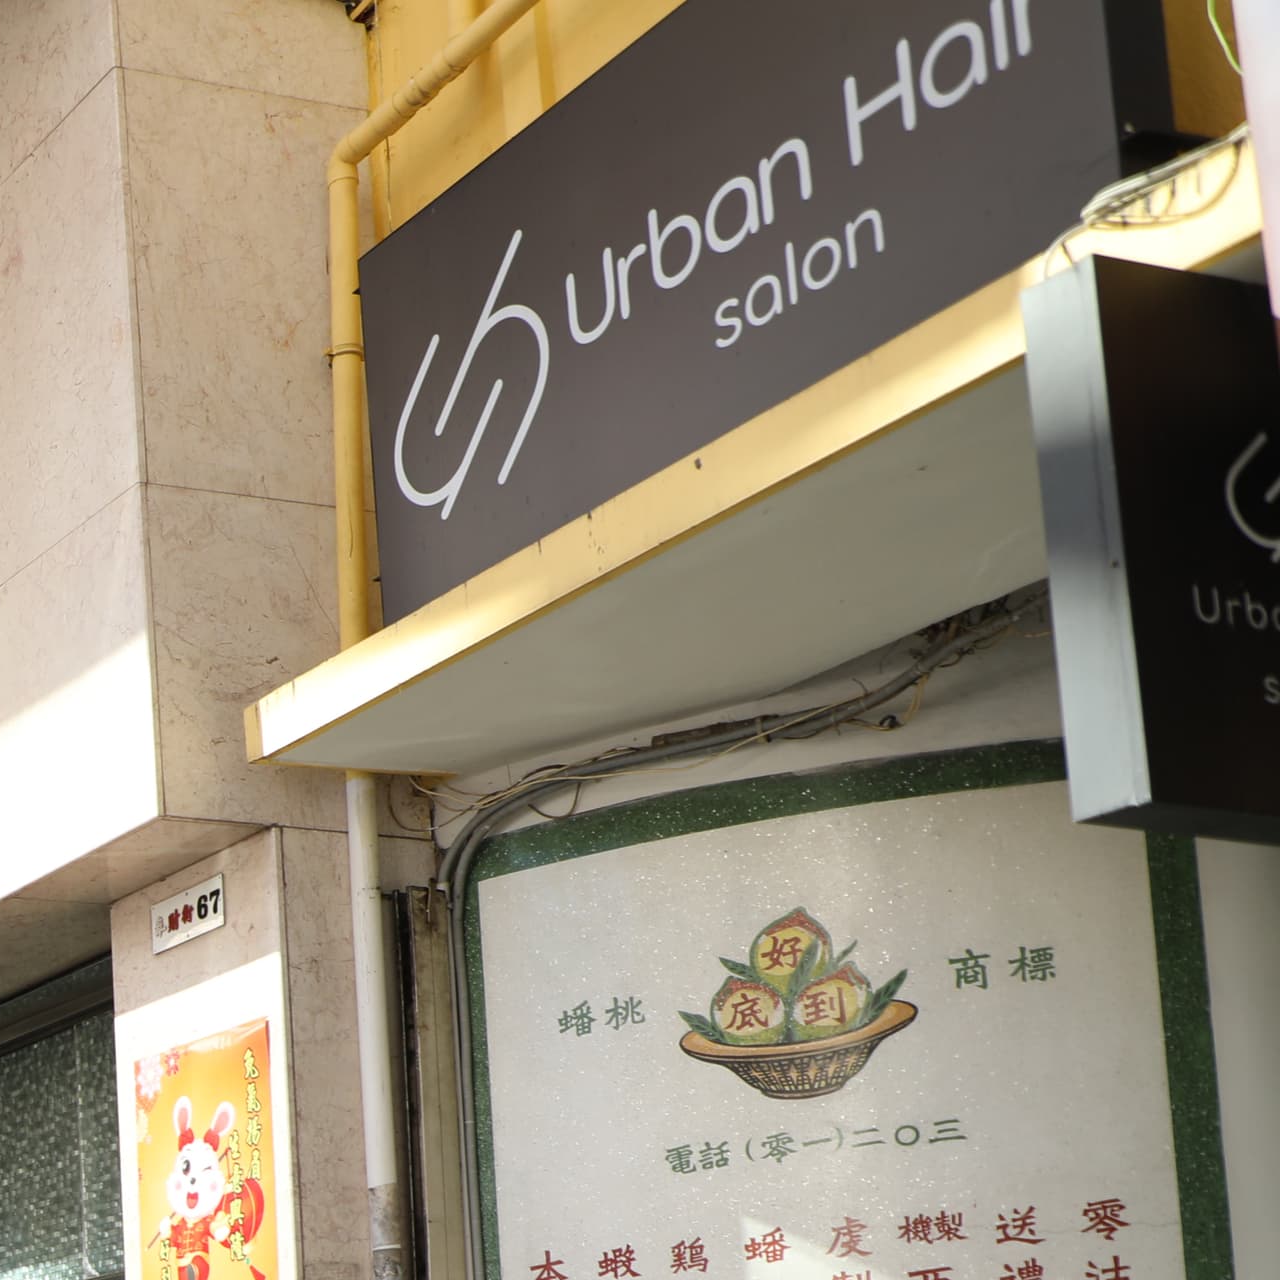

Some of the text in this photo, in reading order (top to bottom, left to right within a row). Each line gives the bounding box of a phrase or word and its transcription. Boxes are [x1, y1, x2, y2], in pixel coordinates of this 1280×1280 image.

[565, 137, 812, 345] Urban
[713, 208, 887, 349] salon
[196, 887, 221, 920] 67
[760, 934, 802, 971] 好
[947, 945, 1058, 991] 商標
[557, 996, 646, 1038] 蟠桃
[726, 984, 847, 1032] 底 到
